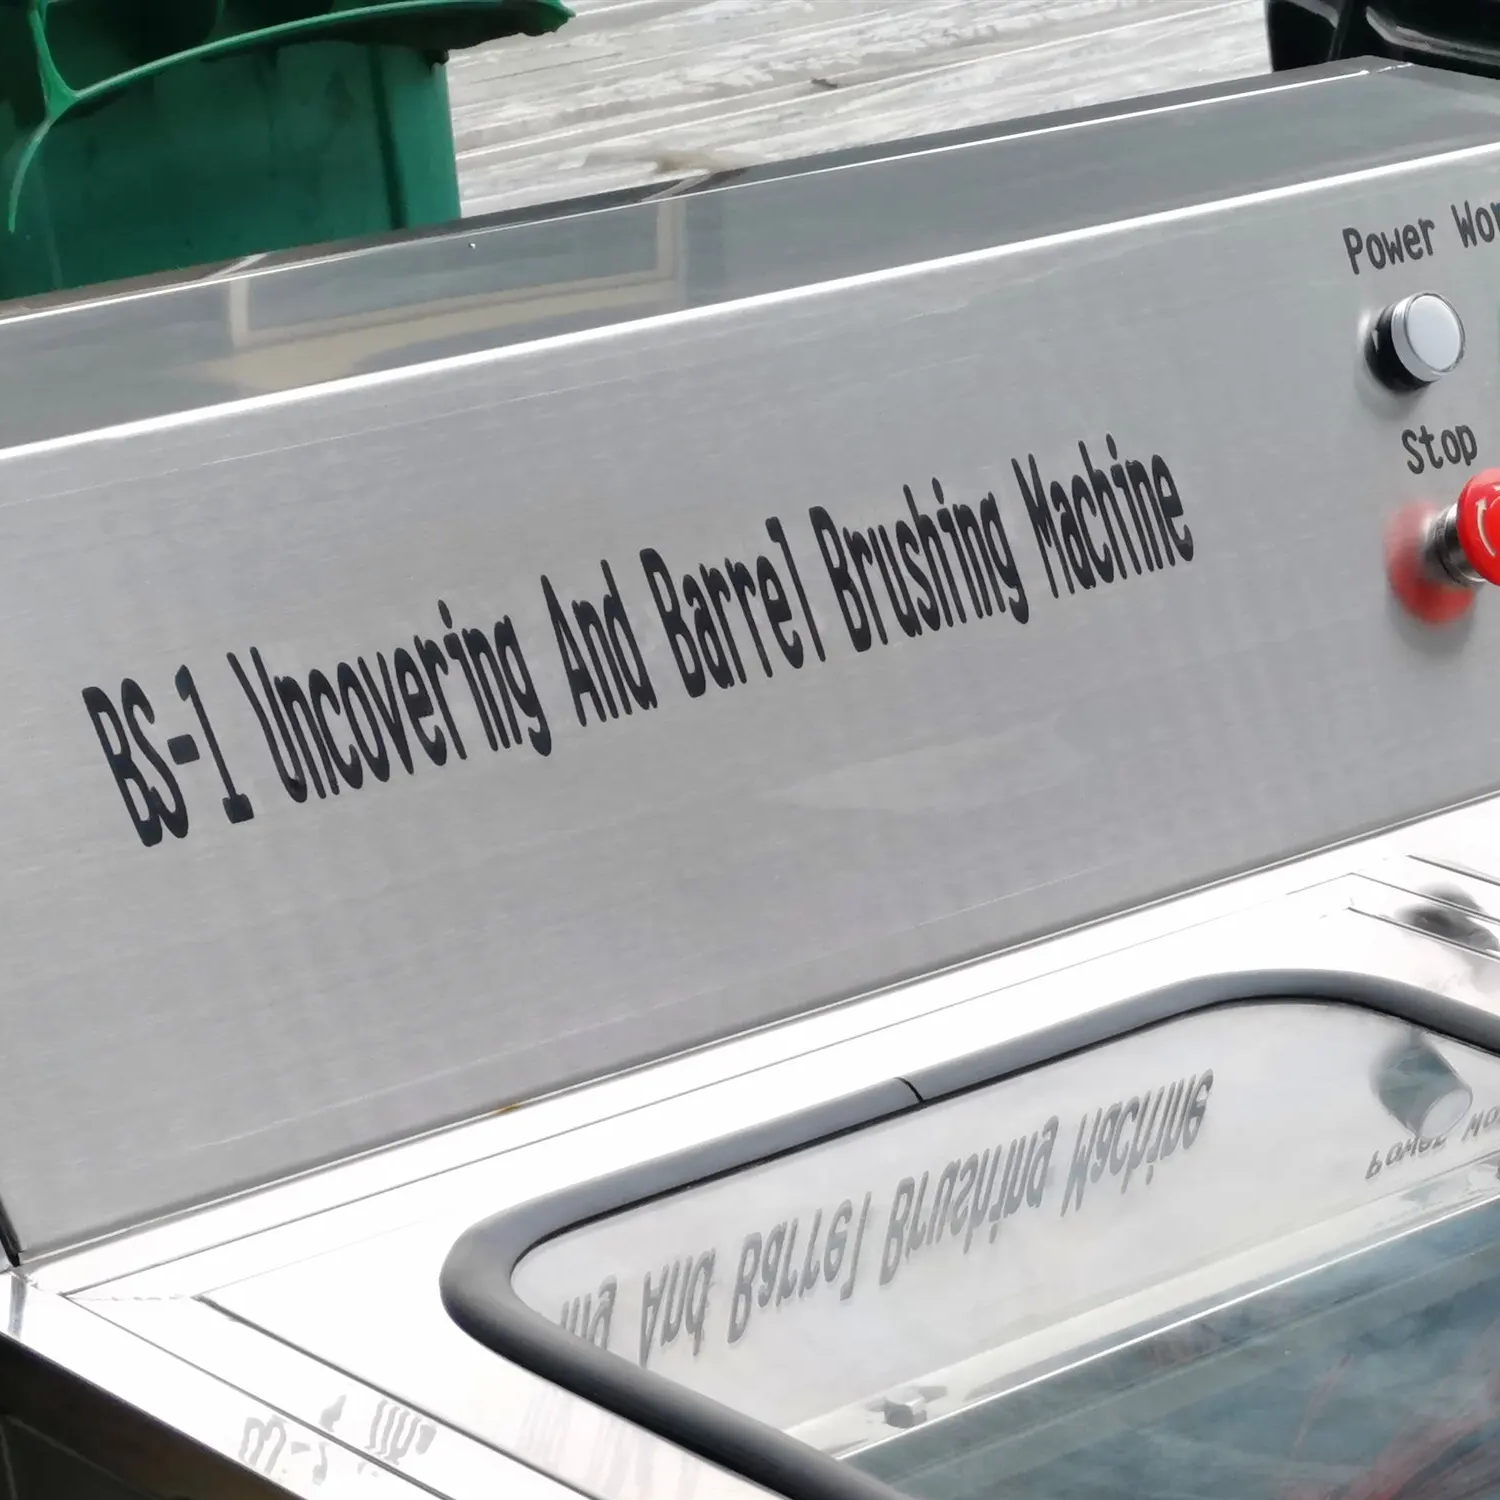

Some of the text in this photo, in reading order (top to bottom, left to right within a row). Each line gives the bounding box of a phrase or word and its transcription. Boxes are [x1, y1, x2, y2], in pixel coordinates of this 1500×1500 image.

[1342, 218, 1435, 276] Power
[1401, 423, 1478, 475] Stop
[82, 433, 1194, 848] BS-1 Uncovering And Barrel Brushing Machine
